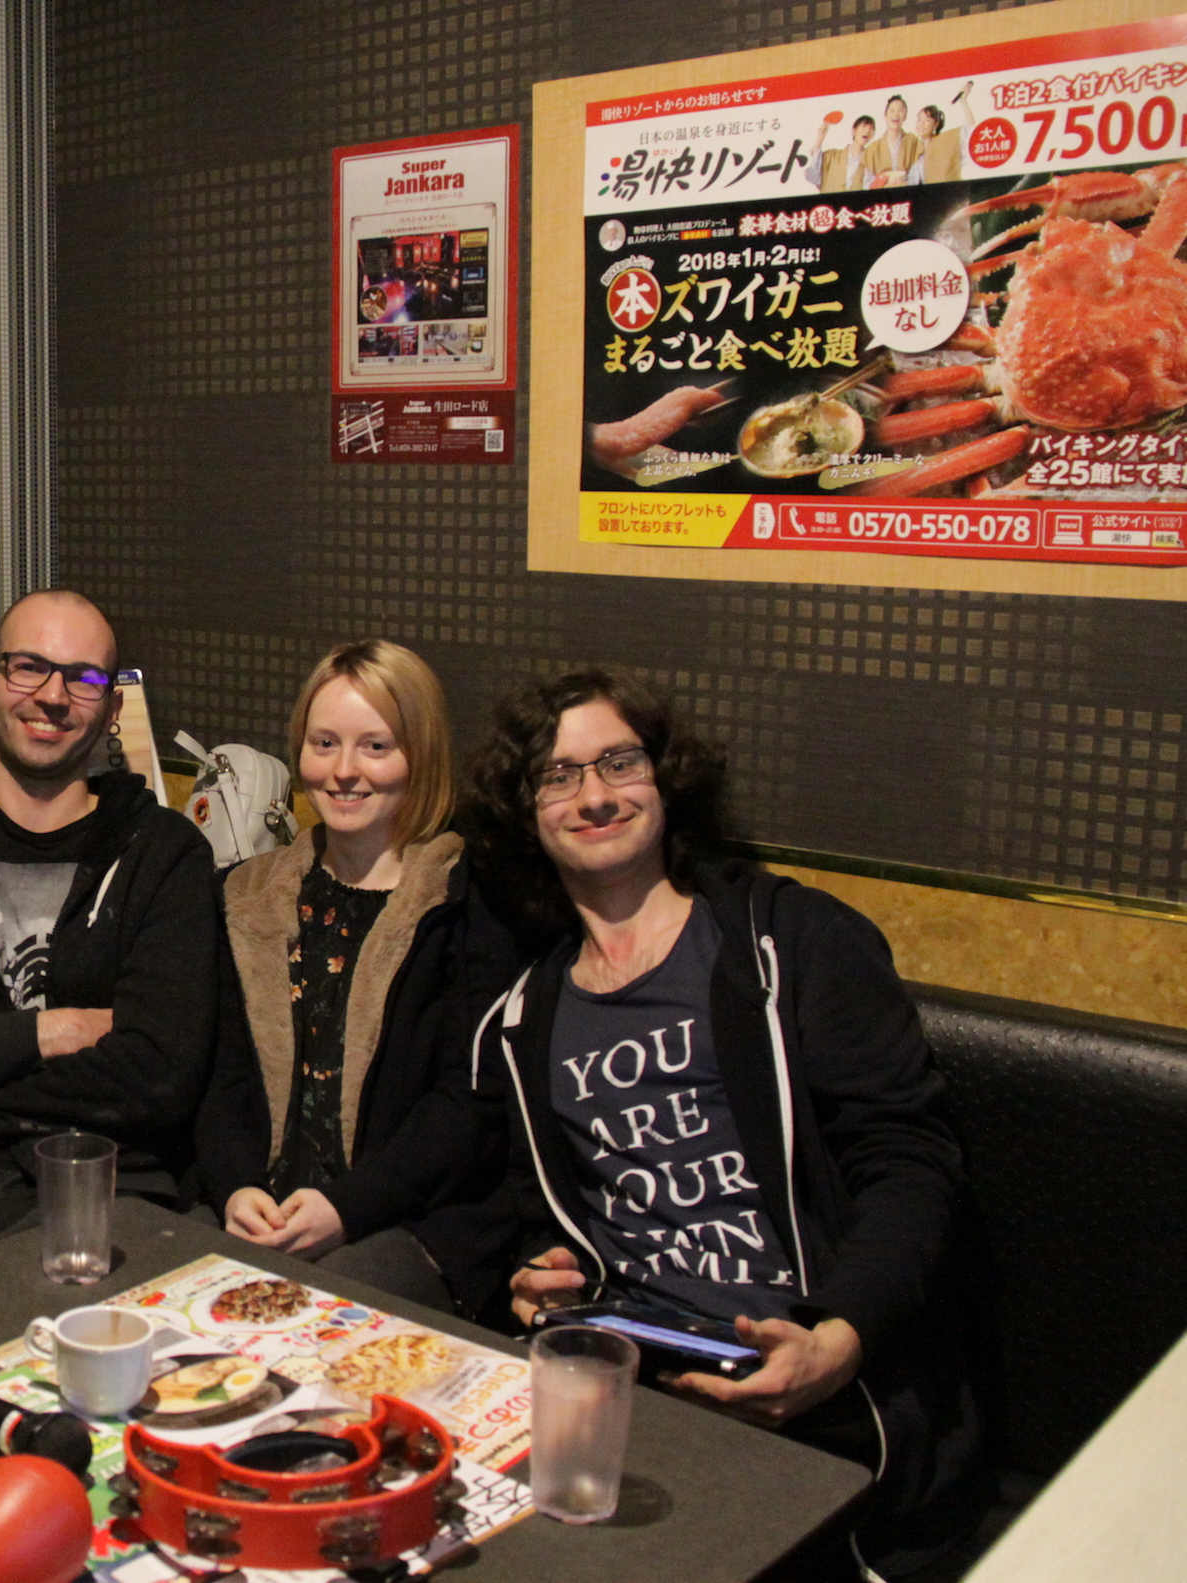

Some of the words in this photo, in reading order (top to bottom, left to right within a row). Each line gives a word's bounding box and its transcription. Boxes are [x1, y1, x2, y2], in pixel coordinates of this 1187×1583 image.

[601, 86, 768, 122] 湯快リゾートからのお知らせです
[638, 117, 782, 146] 日本の温泉を身近にする
[979, 125, 1006, 140] 大人
[1023, 95, 1187, 164] 7,500
[974, 139, 1012, 154] お1人様
[402, 158, 447, 175] Super
[597, 138, 809, 202] 湯快リゾート
[383, 171, 465, 198] Jankara
[737, 202, 911, 236] 豪華食材超食べ放題
[868, 270, 964, 307] 追加料金
[895, 304, 940, 332] なし
[603, 325, 860, 374] まるごと食べ放題
[1029, 434, 1187, 457] バイキングタイ
[1027, 459, 1187, 486] 全25館にて実
[598, 501, 727, 519] フロントにパンフレットも
[815, 511, 838, 525] 電話
[1091, 514, 1152, 529] 公式サイト
[598, 517, 690, 536] 設置しております。
[848, 511, 1031, 543] 0570-550-078
[562, 1018, 695, 1101] YOU
[590, 1087, 709, 1160] ARE
[601, 1150, 759, 1220] YOUR
